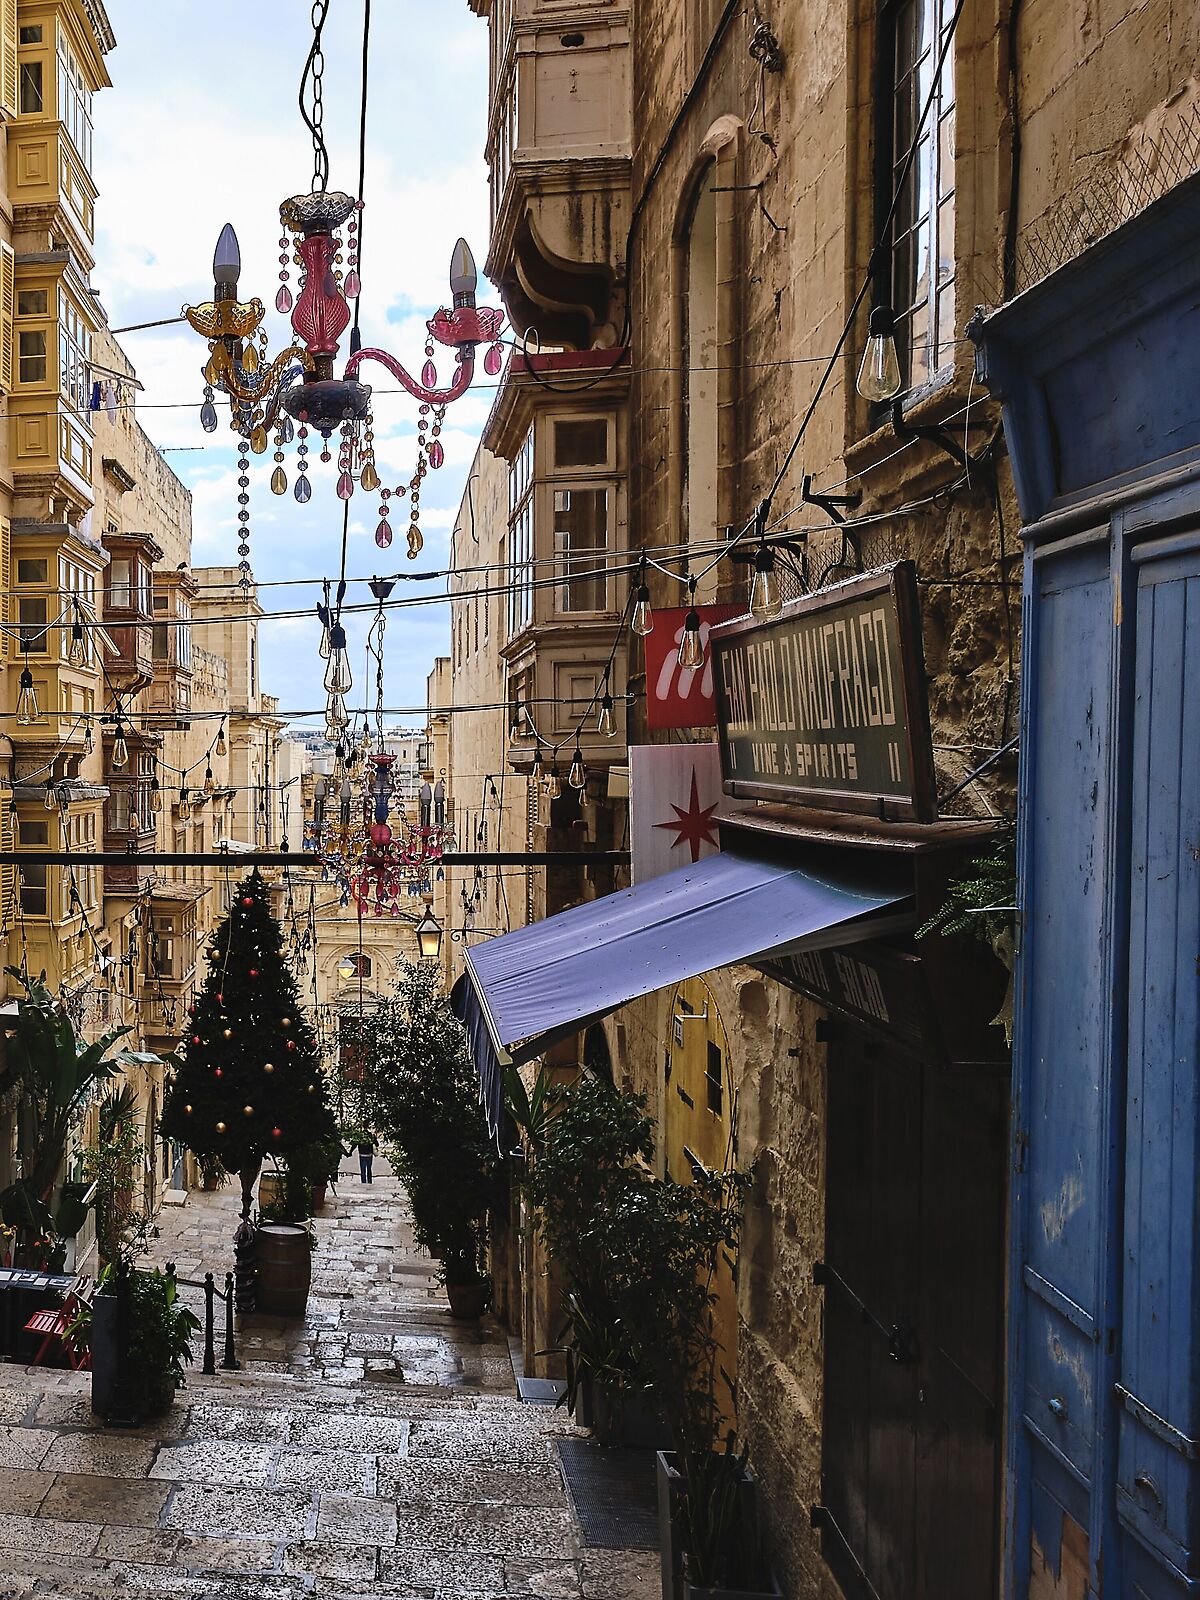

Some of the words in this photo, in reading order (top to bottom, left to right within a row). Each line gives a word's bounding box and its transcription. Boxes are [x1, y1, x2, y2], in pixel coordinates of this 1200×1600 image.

[721, 647, 749, 731] SAN
[747, 636, 796, 731] PAOLO
[793, 608, 896, 730] NAUFRAGO
[783, 742, 792, 776] &
[795, 742, 859, 780] SPIRITS
[832, 951, 890, 1023] SALAD
